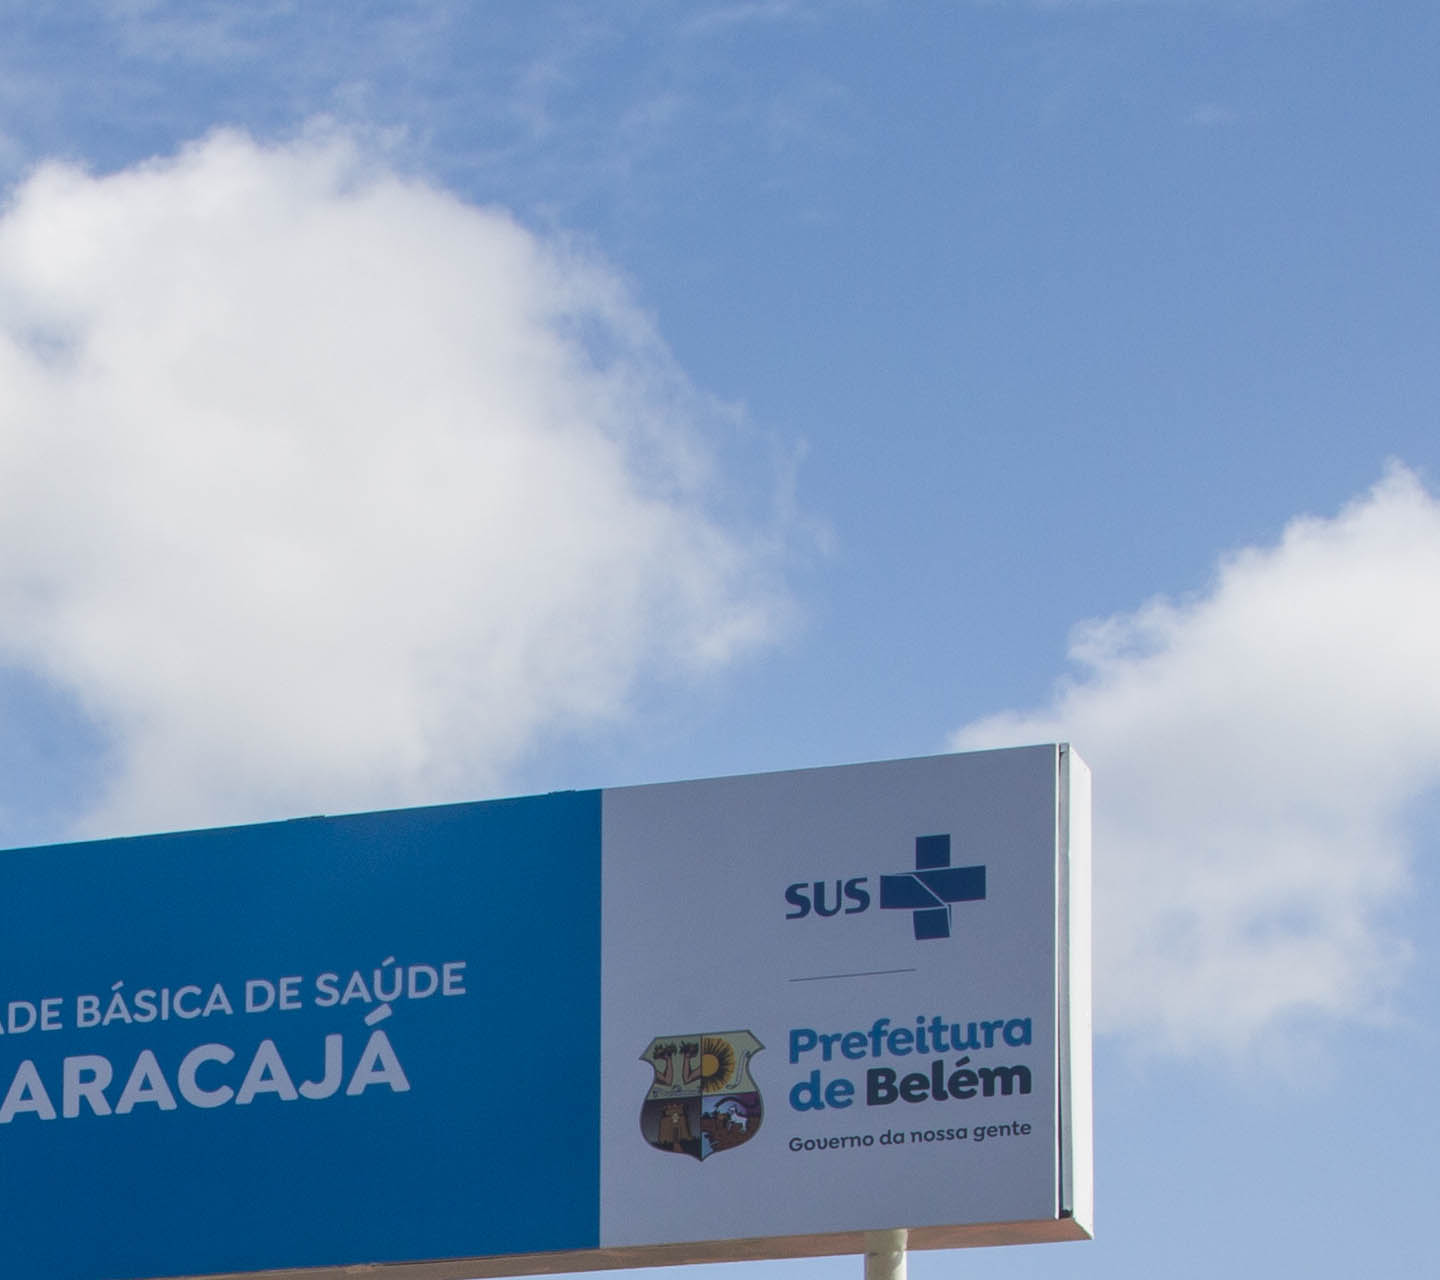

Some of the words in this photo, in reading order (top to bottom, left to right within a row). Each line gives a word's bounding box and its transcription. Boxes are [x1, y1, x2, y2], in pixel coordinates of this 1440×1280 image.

[784, 877, 871, 920] SUS
[77, 981, 233, 1027] BÁSICA
[245, 976, 302, 1013] DE
[315, 956, 466, 1007] SAÚDE
[788, 1015, 1033, 1065] Prefeitura
[788, 1069, 856, 1112] de
[866, 1056, 1033, 1106] Belém
[788, 1135, 875, 1152] Governo
[879, 1130, 905, 1146] da
[910, 1127, 969, 1143] nossa
[973, 1120, 1032, 1143] gente
